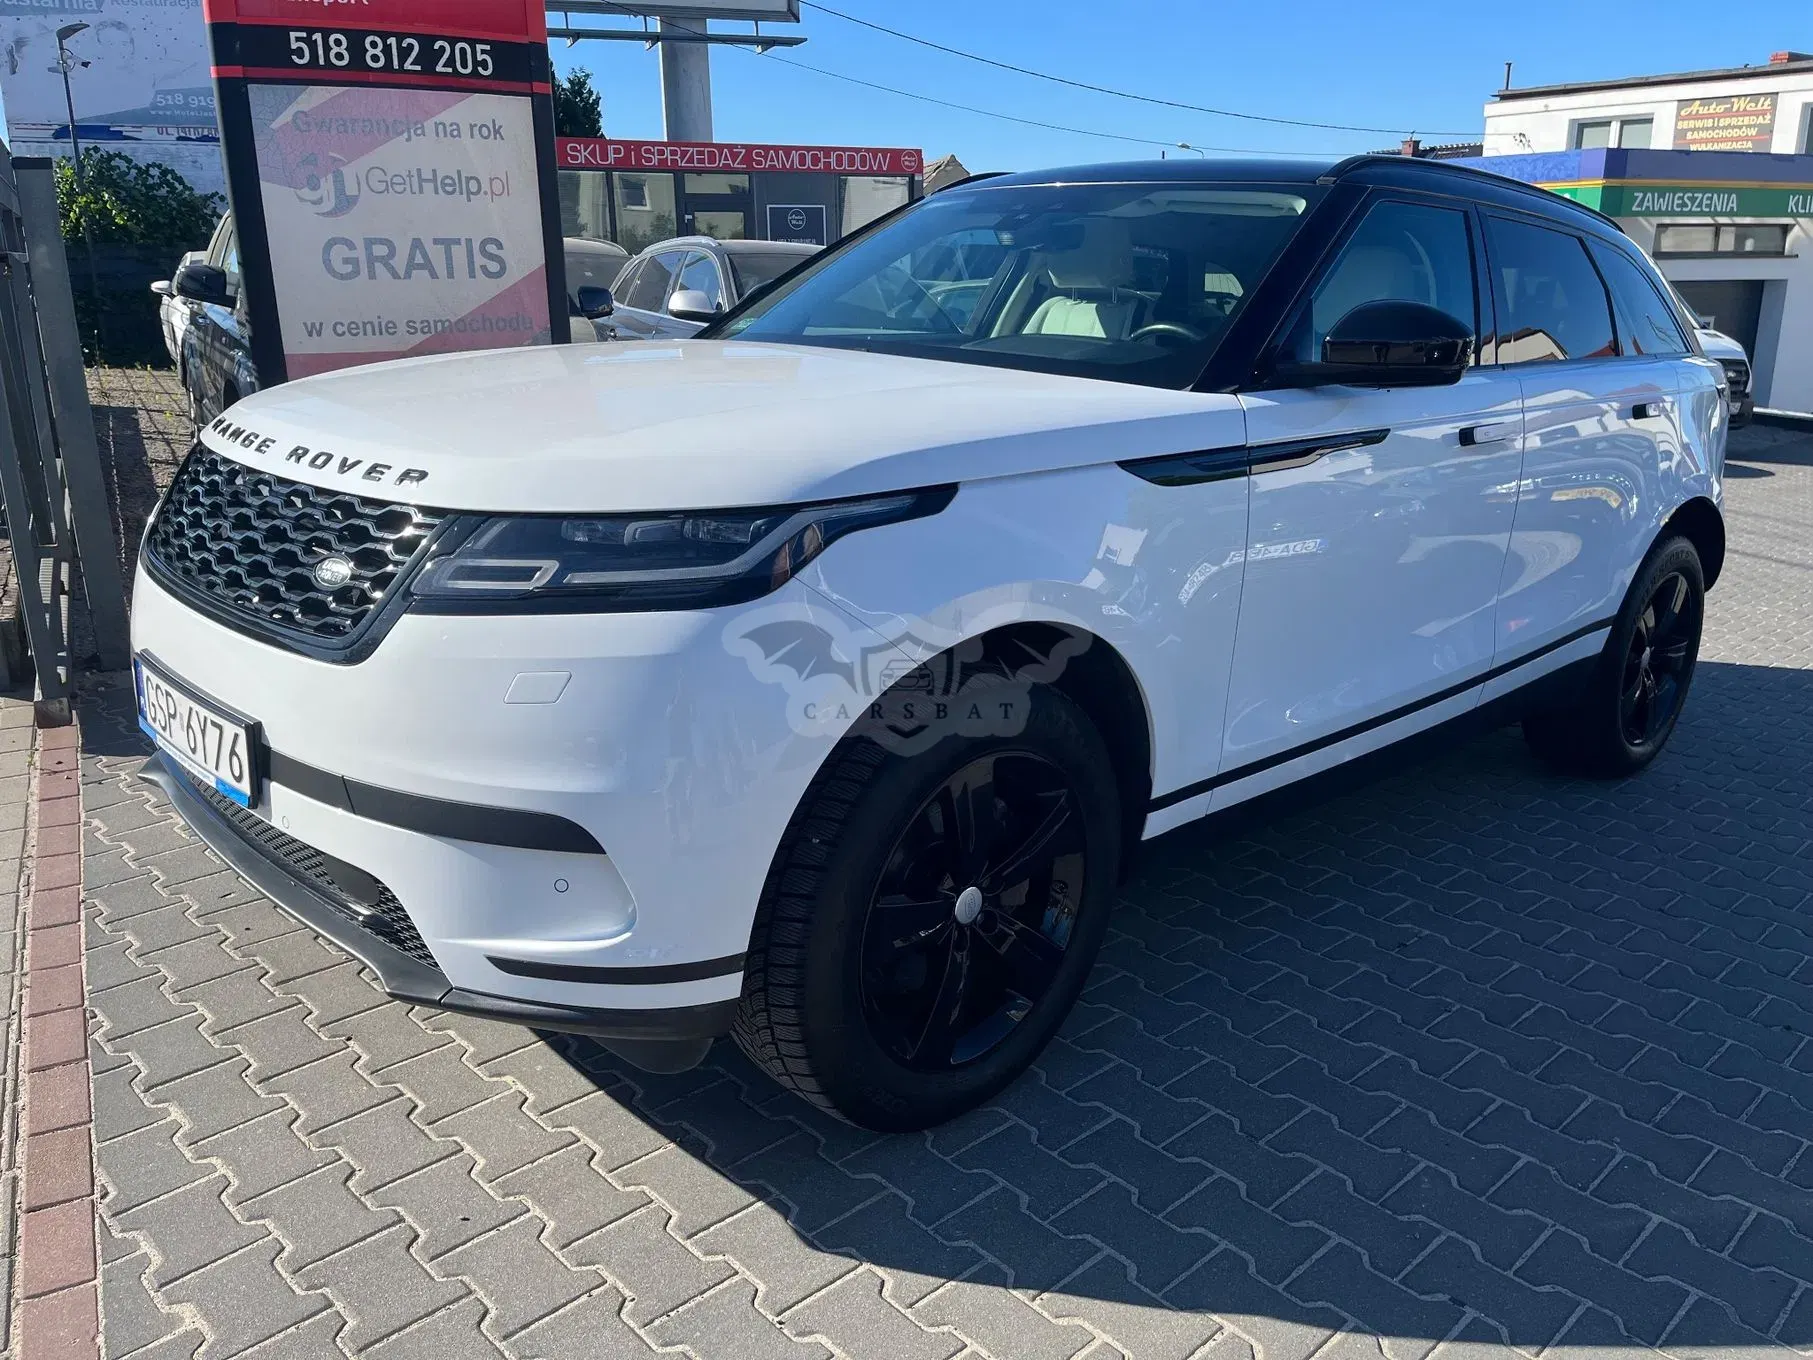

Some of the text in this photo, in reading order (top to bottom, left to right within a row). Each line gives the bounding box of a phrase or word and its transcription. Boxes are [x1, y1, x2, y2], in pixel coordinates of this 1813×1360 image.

[288, 31, 493, 76] 518 812 205
[156, 93, 184, 106] 518
[1680, 100, 1730, 116] Auto
[292, 110, 505, 142] Gwarancja na rok
[1677, 119, 1713, 129] SERWIS
[1719, 113, 1771, 126] SPRZEDAŻ
[1686, 127, 1758, 139] SAMOCHODÓW
[567, 143, 624, 165] SKUP
[631, 145, 635, 165] i
[641, 145, 747, 169] SPRZEDAŻ
[752, 148, 890, 171] SAMOCHODÓW
[1690, 141, 1753, 151] WULKANIZACJA
[365, 166, 511, 202] GetHelp.pl
[1631, 192, 1737, 212] ZAWIESZENIA
[322, 237, 507, 281] GRATIS
[302, 313, 533, 338] w cenie samochodu
[211, 415, 429, 487] RANGE ROVER
[146, 675, 177, 739] GSP
[186, 706, 243, 784] 6Y76
